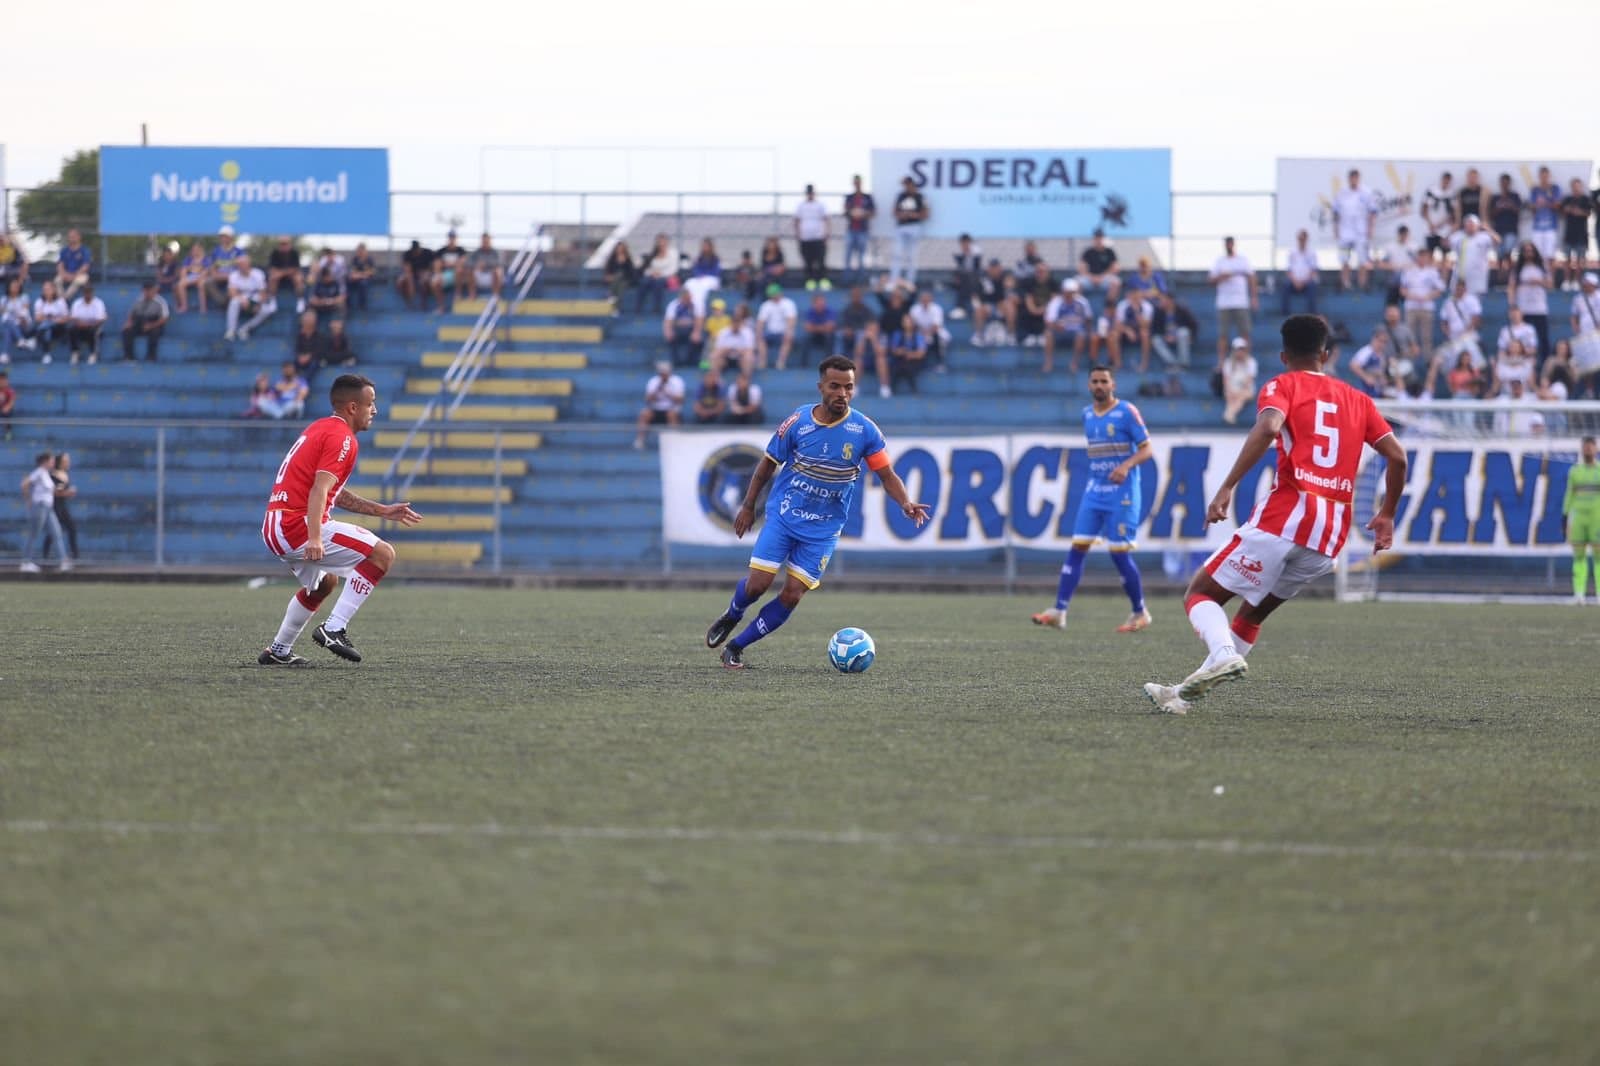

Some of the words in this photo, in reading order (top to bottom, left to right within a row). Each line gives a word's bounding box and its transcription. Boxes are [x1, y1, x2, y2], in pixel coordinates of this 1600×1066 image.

[151, 170, 347, 203] Nutrimental
[910, 158, 1098, 189] SIDERAL
[1312, 399, 1340, 469] 5
[276, 435, 307, 484] 8
[1294, 467, 1338, 490] Unimed
[1229, 559, 1261, 586] contato
